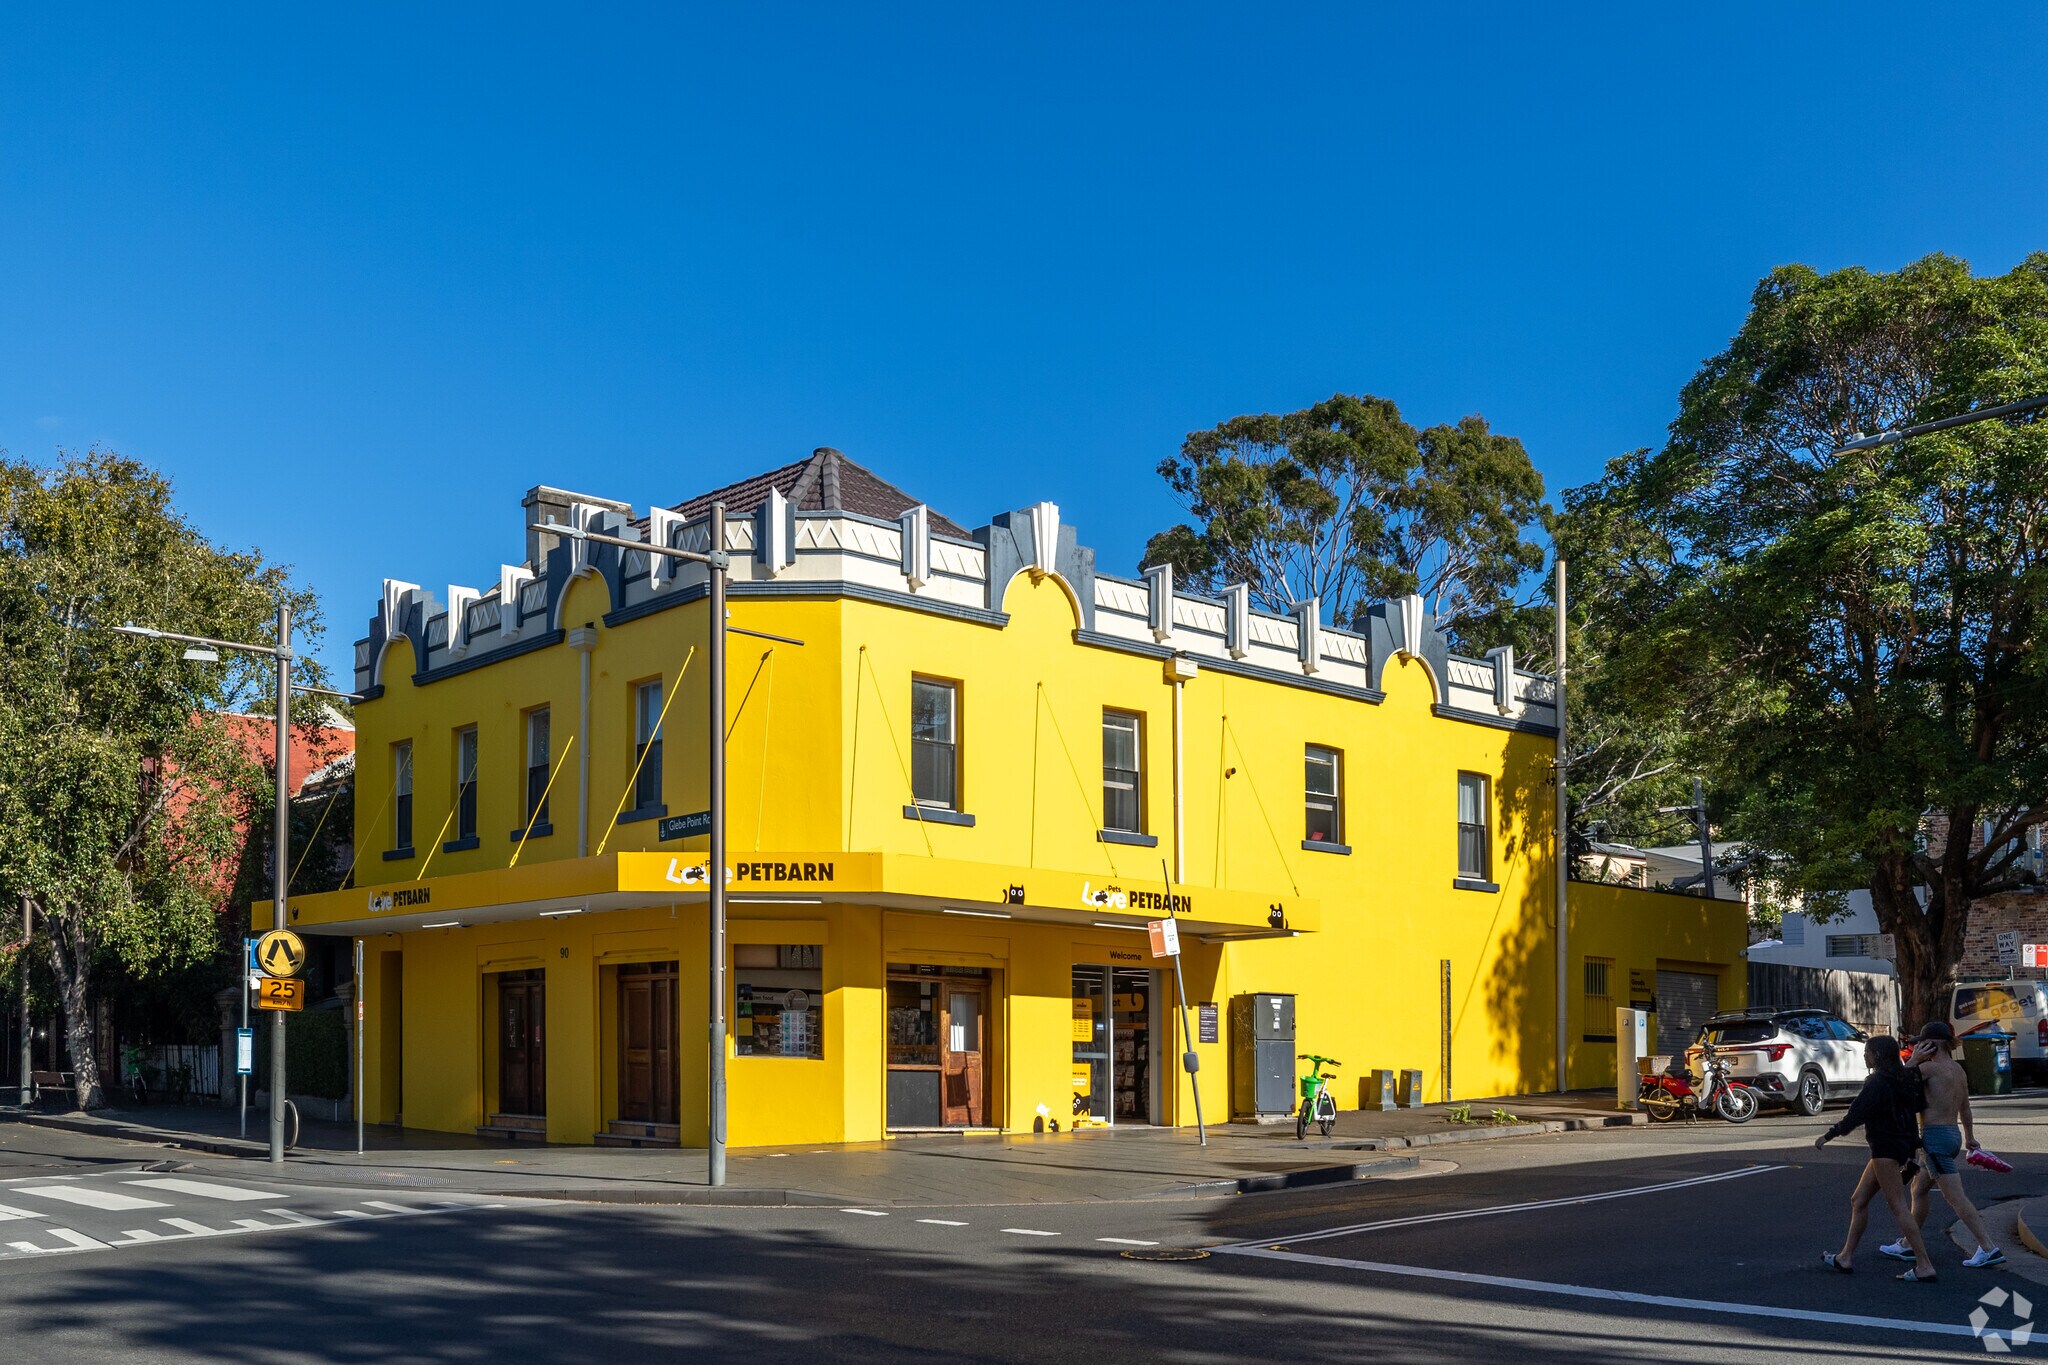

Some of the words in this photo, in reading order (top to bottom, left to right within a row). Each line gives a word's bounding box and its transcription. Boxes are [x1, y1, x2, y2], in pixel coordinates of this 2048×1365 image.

[669, 819, 686, 831] Glebe
[686, 816, 702, 828] Point
[736, 862, 834, 882] PETBARN
[1107, 885, 1121, 893] Pets
[368, 890, 392, 912] Love
[393, 887, 430, 907] PETBARN
[1081, 881, 1127, 910] Love
[1129, 890, 1192, 913] PETBARN
[1998, 932, 2013, 941] ONE
[1998, 940, 2014, 949] WAY
[560, 947, 569, 959] 90
[1109, 950, 1142, 961] Welcome
[270, 981, 295, 999] 25
[1990, 994, 2035, 1018] goget
